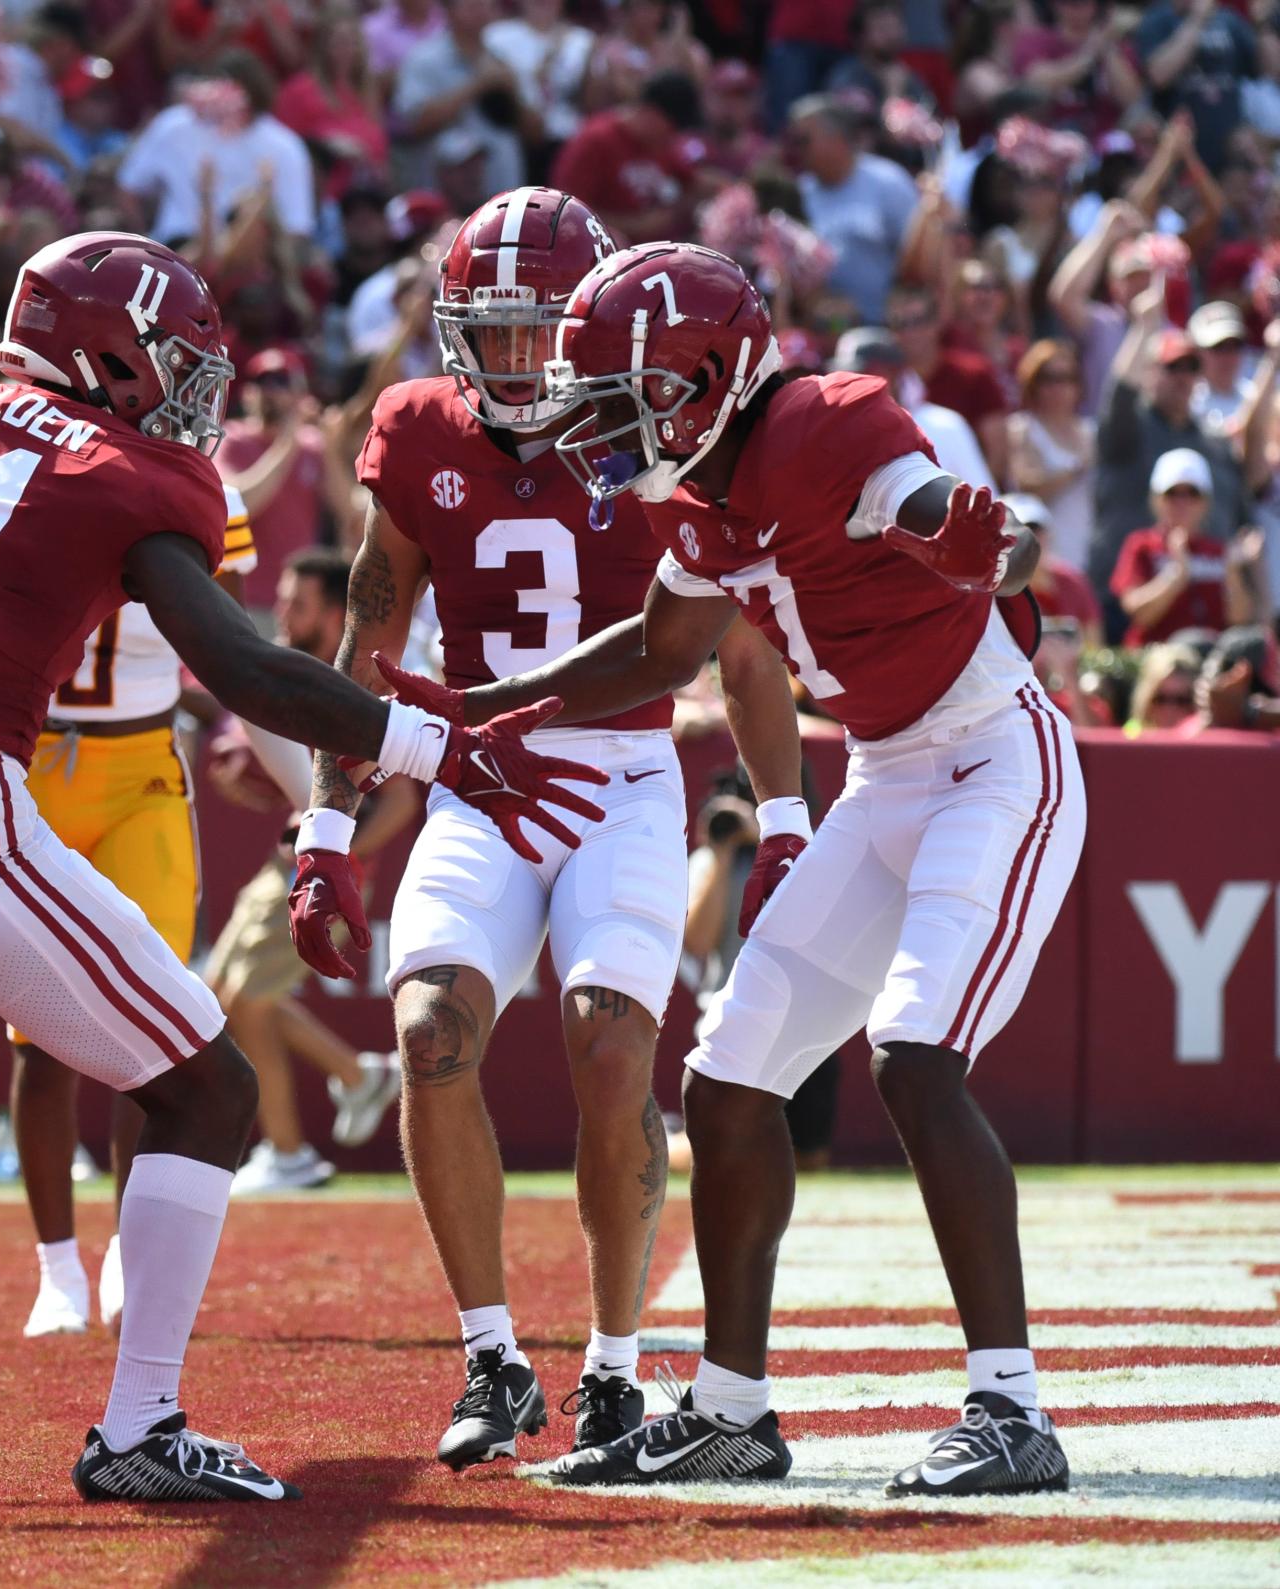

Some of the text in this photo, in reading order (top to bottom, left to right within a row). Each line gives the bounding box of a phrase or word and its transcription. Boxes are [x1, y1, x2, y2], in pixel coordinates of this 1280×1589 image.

[125, 264, 170, 324] 11
[490, 288, 521, 299] BAMA
[641, 272, 685, 327] 7
[430, 470, 467, 509] SEC
[475, 518, 582, 681] 3
[720, 555, 847, 699] 7
[1124, 880, 1280, 1064] Y
[82, 1440, 101, 1464] NIKE
